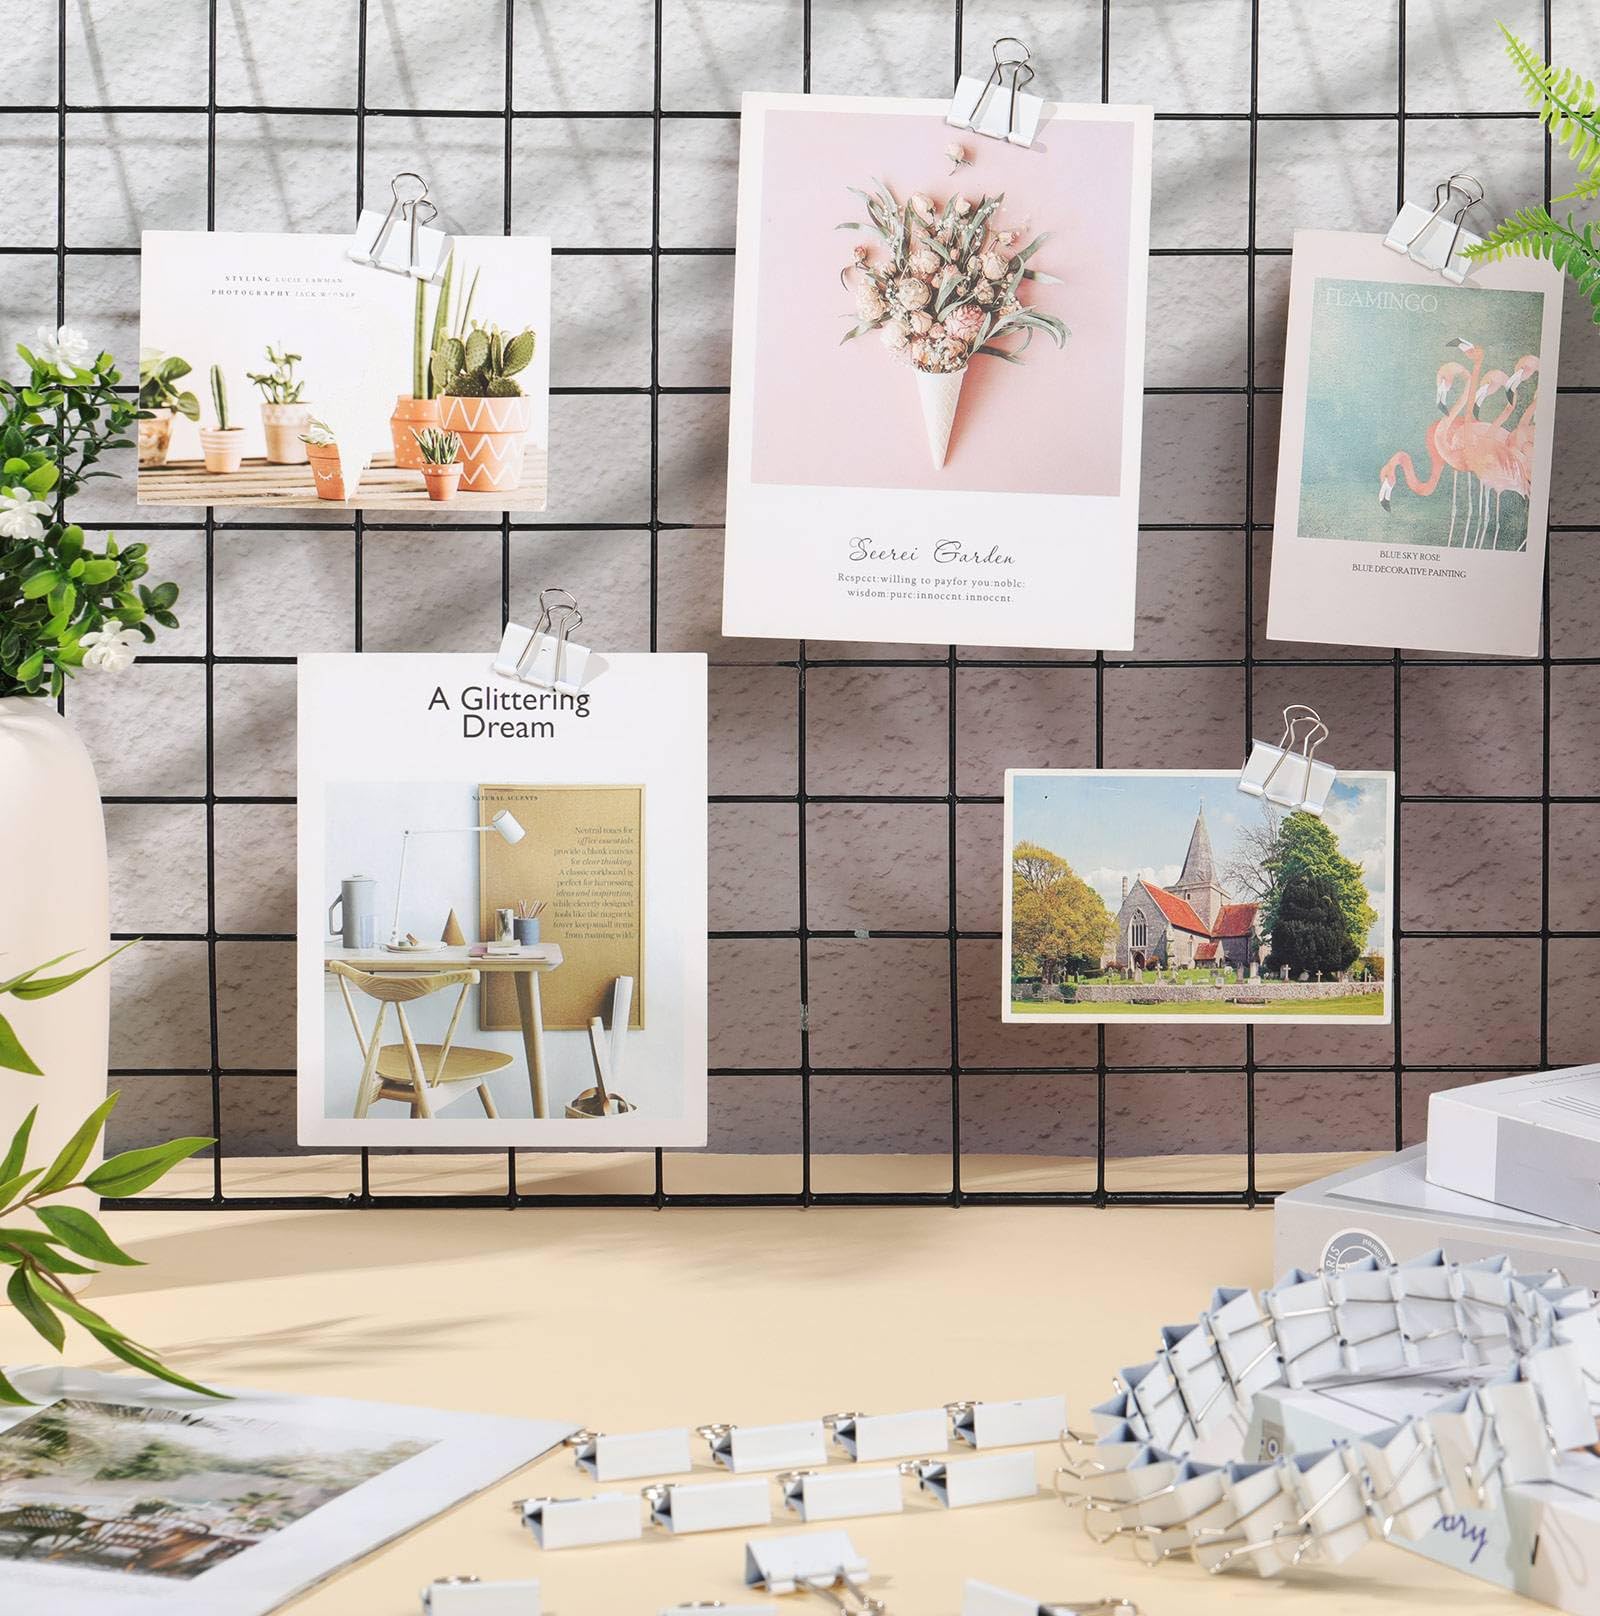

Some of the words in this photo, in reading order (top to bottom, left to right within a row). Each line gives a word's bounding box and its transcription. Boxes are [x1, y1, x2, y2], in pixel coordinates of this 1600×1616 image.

[225, 275, 271, 283] STYLING
[211, 289, 290, 297] PHOTOGRAPHY
[1326, 288, 1439, 313] FLAMINGO
[933, 539, 1016, 564] Garden
[1379, 550, 1401, 560] BLUE
[1402, 551, 1418, 561] SKY
[1419, 552, 1441, 562] ROSE
[1352, 563, 1373, 573] BLUE
[1374, 564, 1427, 577] DECORATIVE
[1428, 568, 1467, 579] PAINTING
[921, 576, 932, 585] to
[427, 686, 450, 711] A
[461, 686, 591, 718] Glittering
[463, 714, 555, 738] Dream
